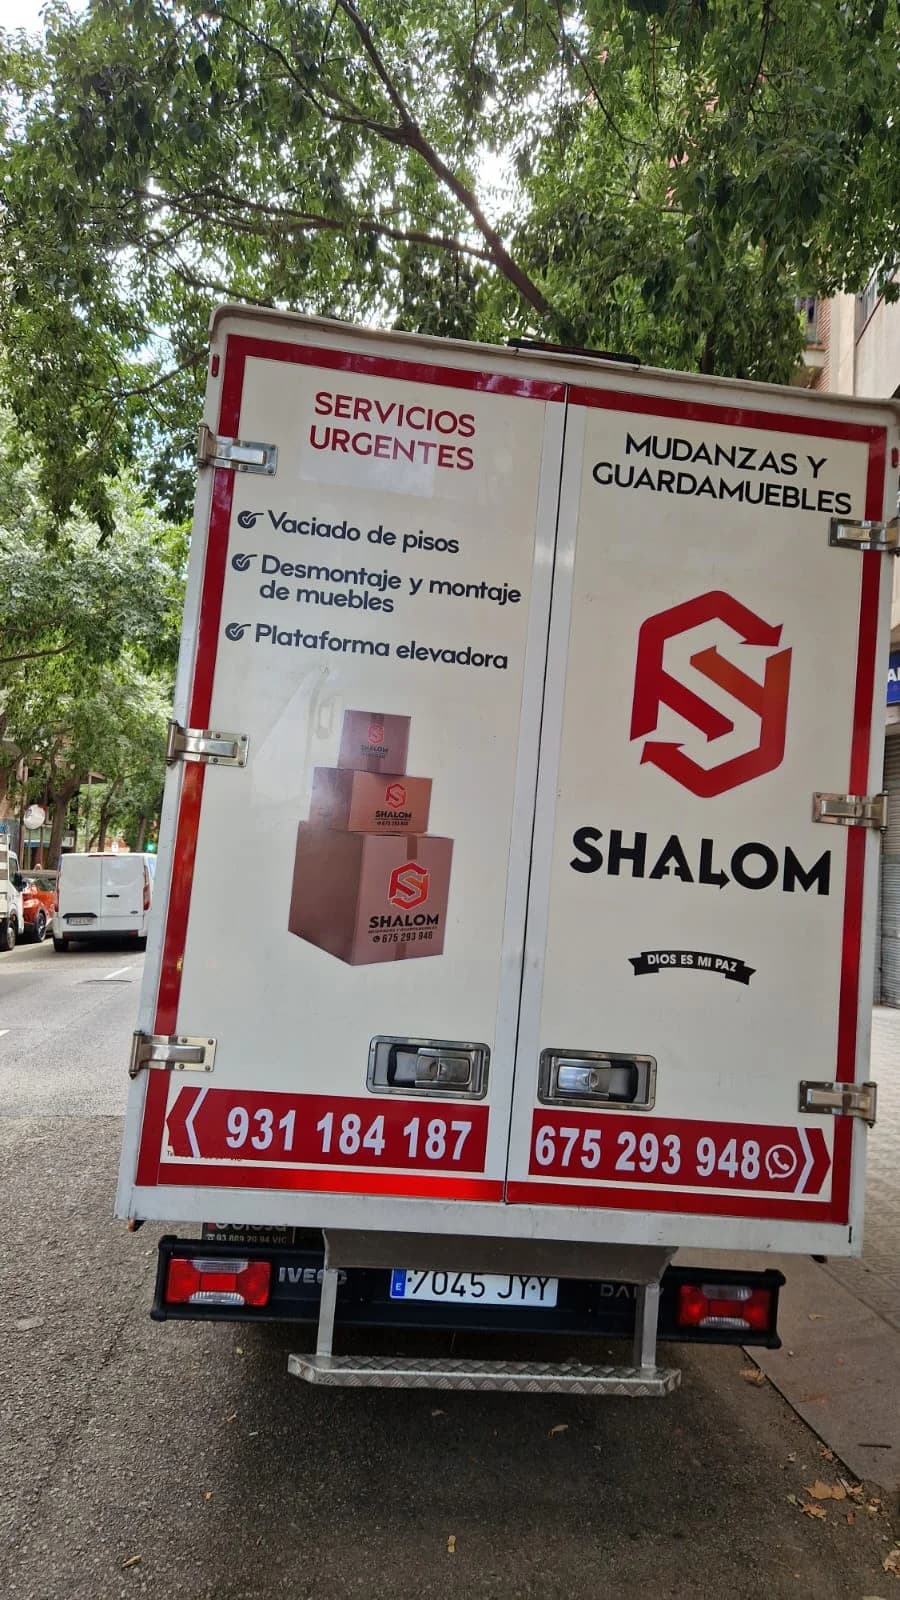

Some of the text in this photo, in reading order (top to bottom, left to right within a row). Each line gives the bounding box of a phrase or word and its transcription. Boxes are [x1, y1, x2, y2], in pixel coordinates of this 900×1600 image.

[314, 391, 476, 437] SERVICIOS
[309, 425, 474, 471] URGENTES
[625, 432, 827, 479] MUDANZAS Y
[592, 462, 852, 515] GUARDAMUEBLES
[268, 510, 460, 553] Vaciado de pisos
[259, 580, 394, 613] de muebles
[261, 554, 522, 606] Desmontaje y montaje
[255, 623, 509, 669] Plataforma elevadora
[375, 810, 412, 818] SHALOM
[570, 826, 831, 896] SHALOM
[369, 914, 439, 928] SHALOM
[382, 933, 398, 943] 675
[400, 932, 416, 942] 293
[647, 953, 738, 972] DIOS ES MI PAZ
[225, 1106, 473, 1161] 931 184 187
[535, 1125, 760, 1180] 675 293 948
[395, 1282, 403, 1291] E
